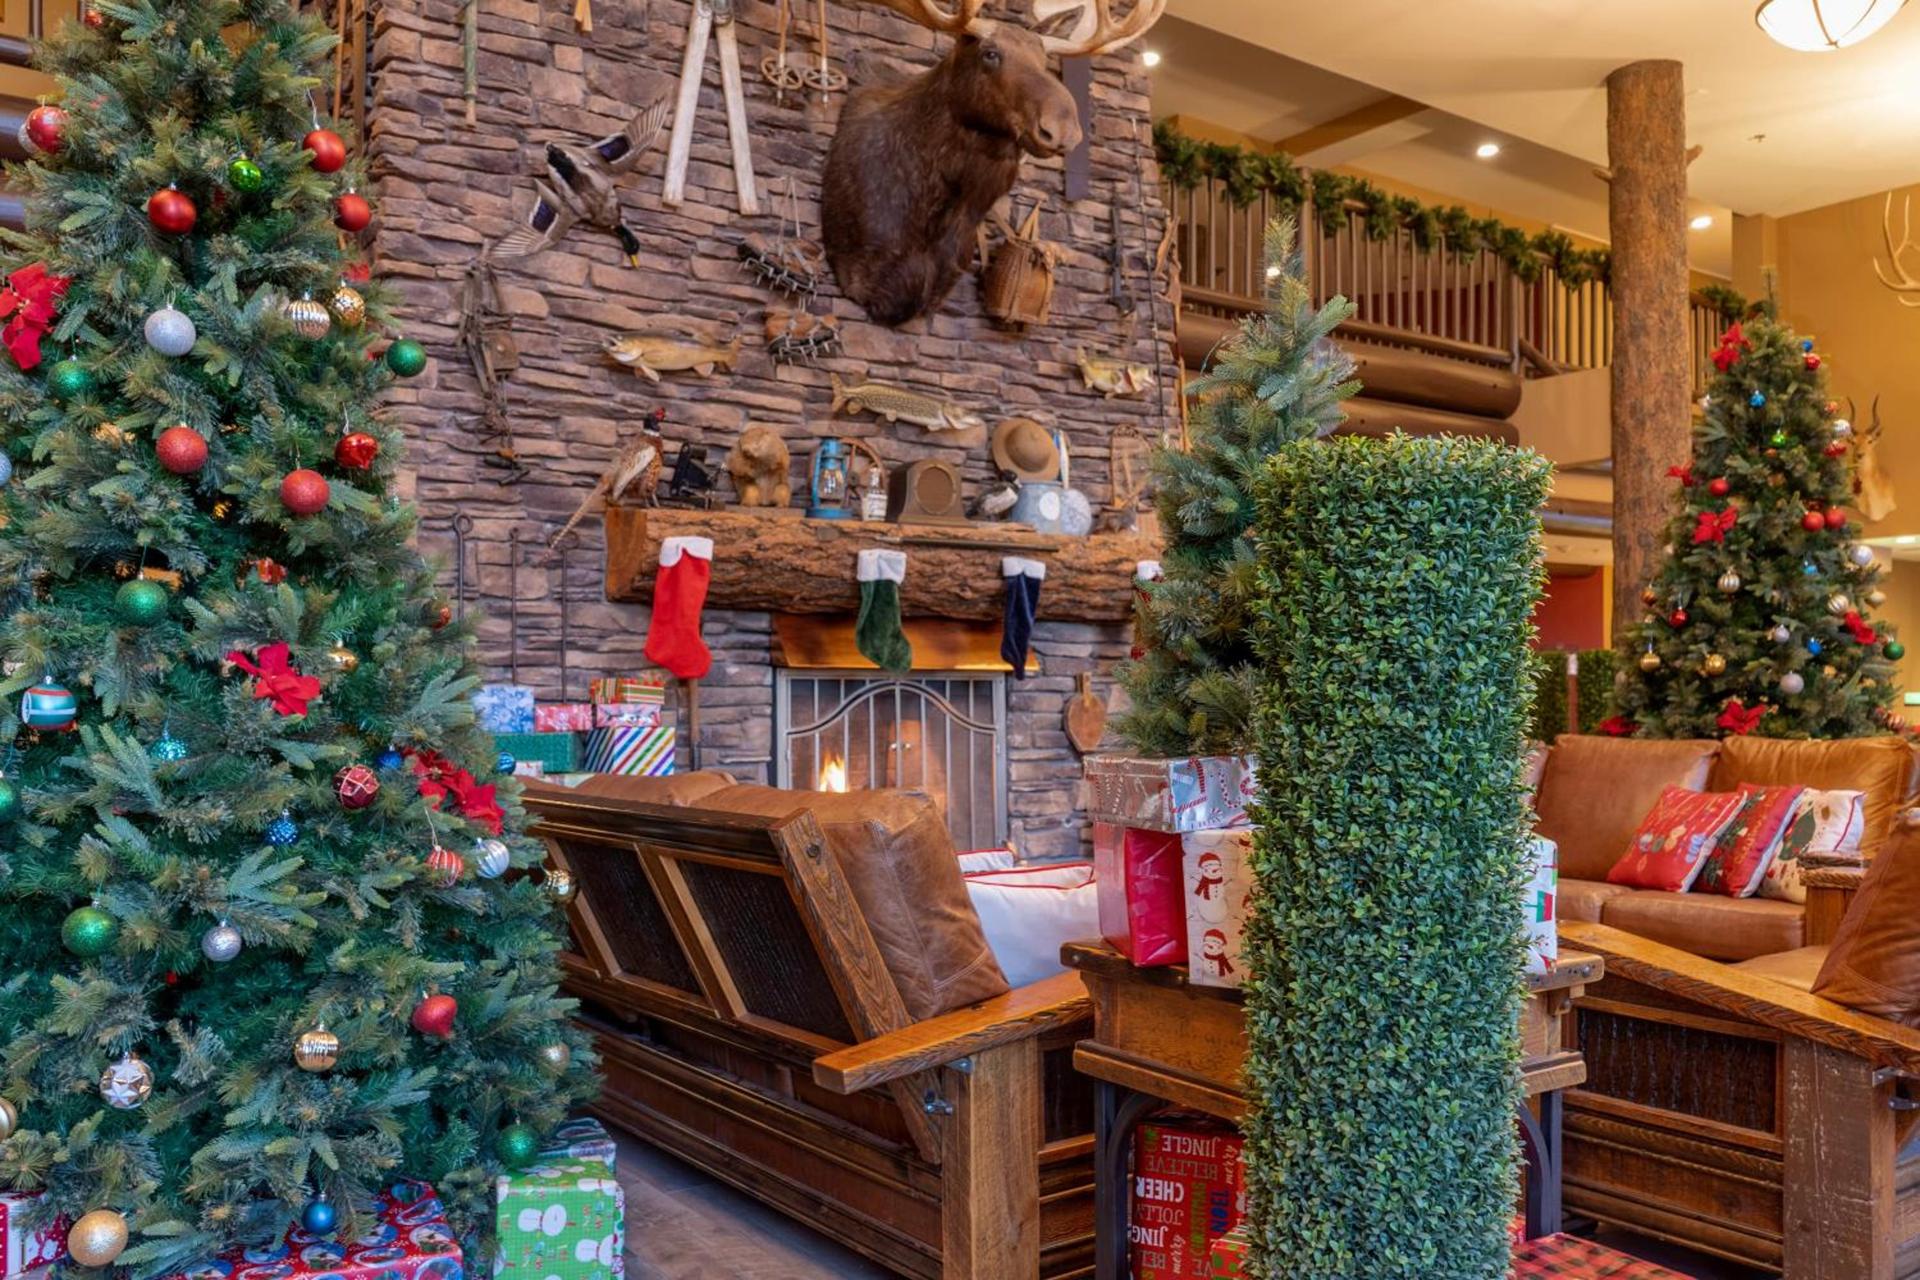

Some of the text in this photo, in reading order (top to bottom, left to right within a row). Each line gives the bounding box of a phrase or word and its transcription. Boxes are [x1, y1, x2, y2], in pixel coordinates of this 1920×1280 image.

[1161, 1134, 1221, 1158] JINGLE
[1145, 1154, 1218, 1180] BELIEVE
[1222, 1144, 1239, 1185] merry
[1136, 1176, 1185, 1203] CHEER
[1136, 1203, 1185, 1226] JOLLY
[1210, 1189, 1229, 1233] NOEL
[1170, 1234, 1186, 1274] merry
